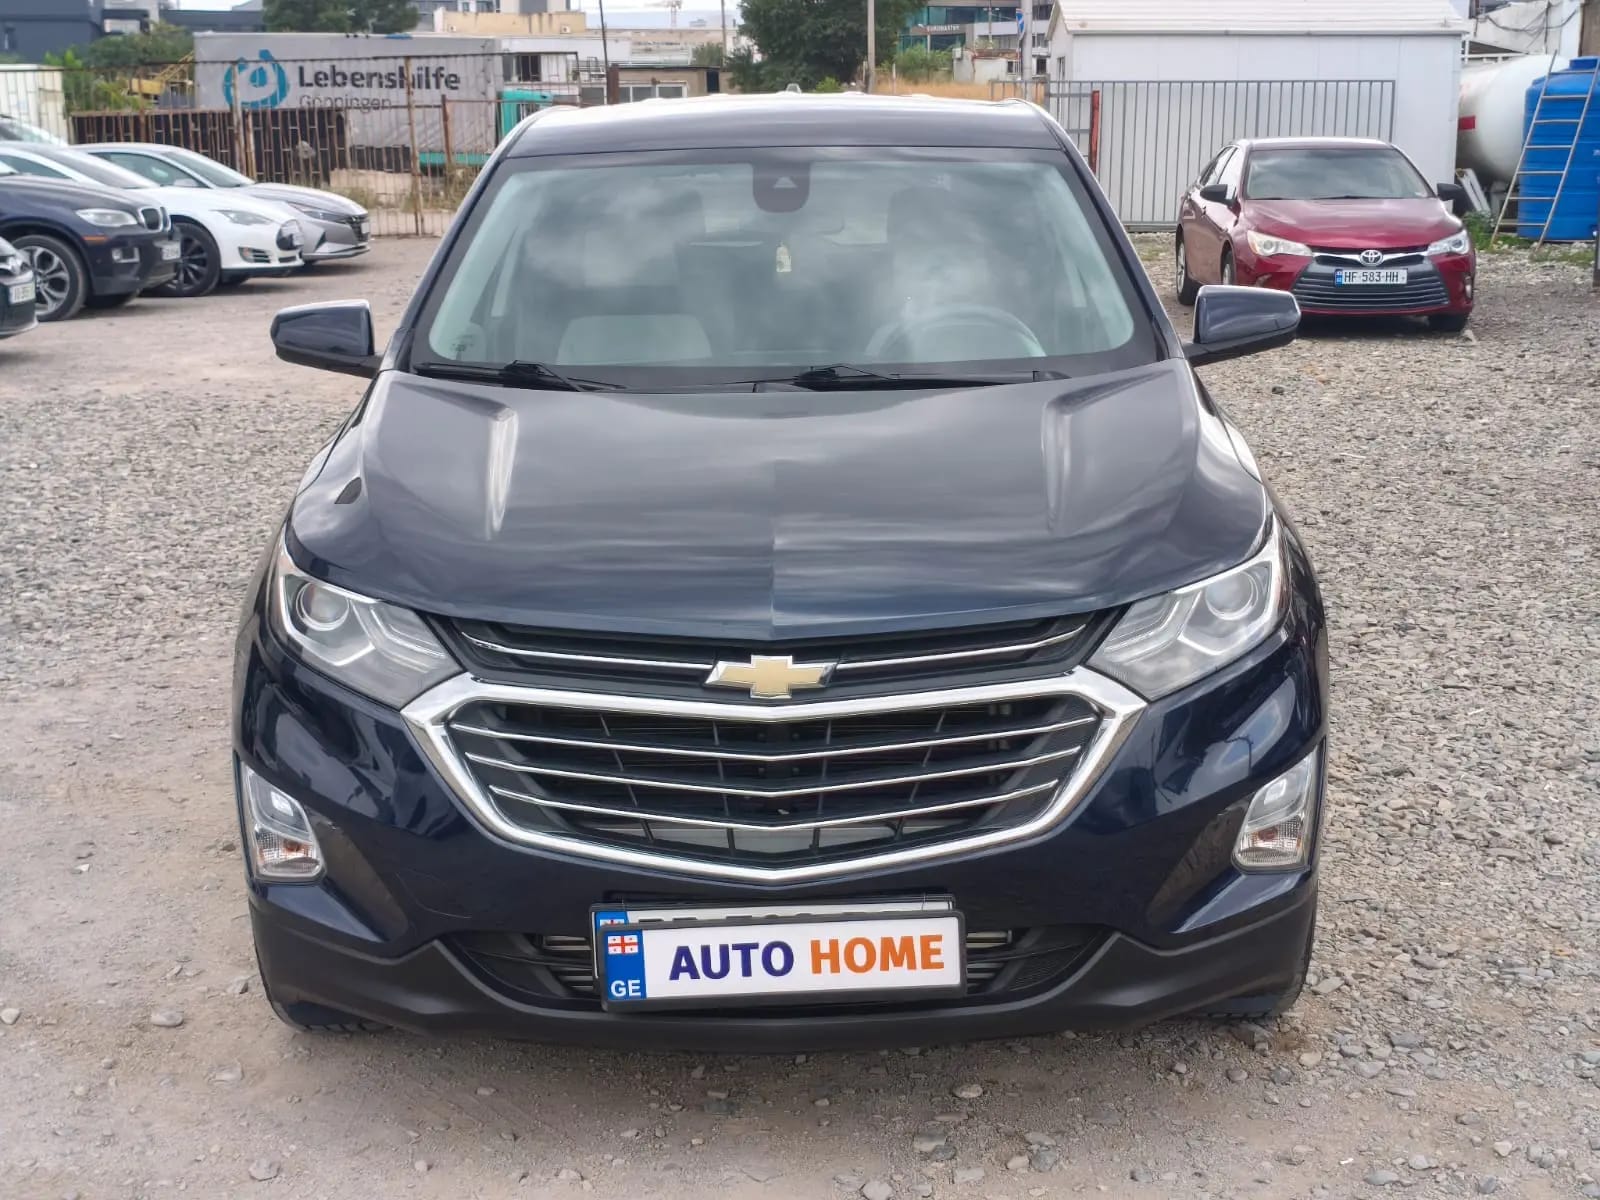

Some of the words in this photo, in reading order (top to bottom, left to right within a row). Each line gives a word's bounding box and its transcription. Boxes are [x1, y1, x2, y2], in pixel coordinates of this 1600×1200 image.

[298, 65, 461, 90] Lebenshilfe
[669, 940, 794, 981] AUTO
[810, 934, 945, 975] HOME
[610, 979, 642, 997] GE
